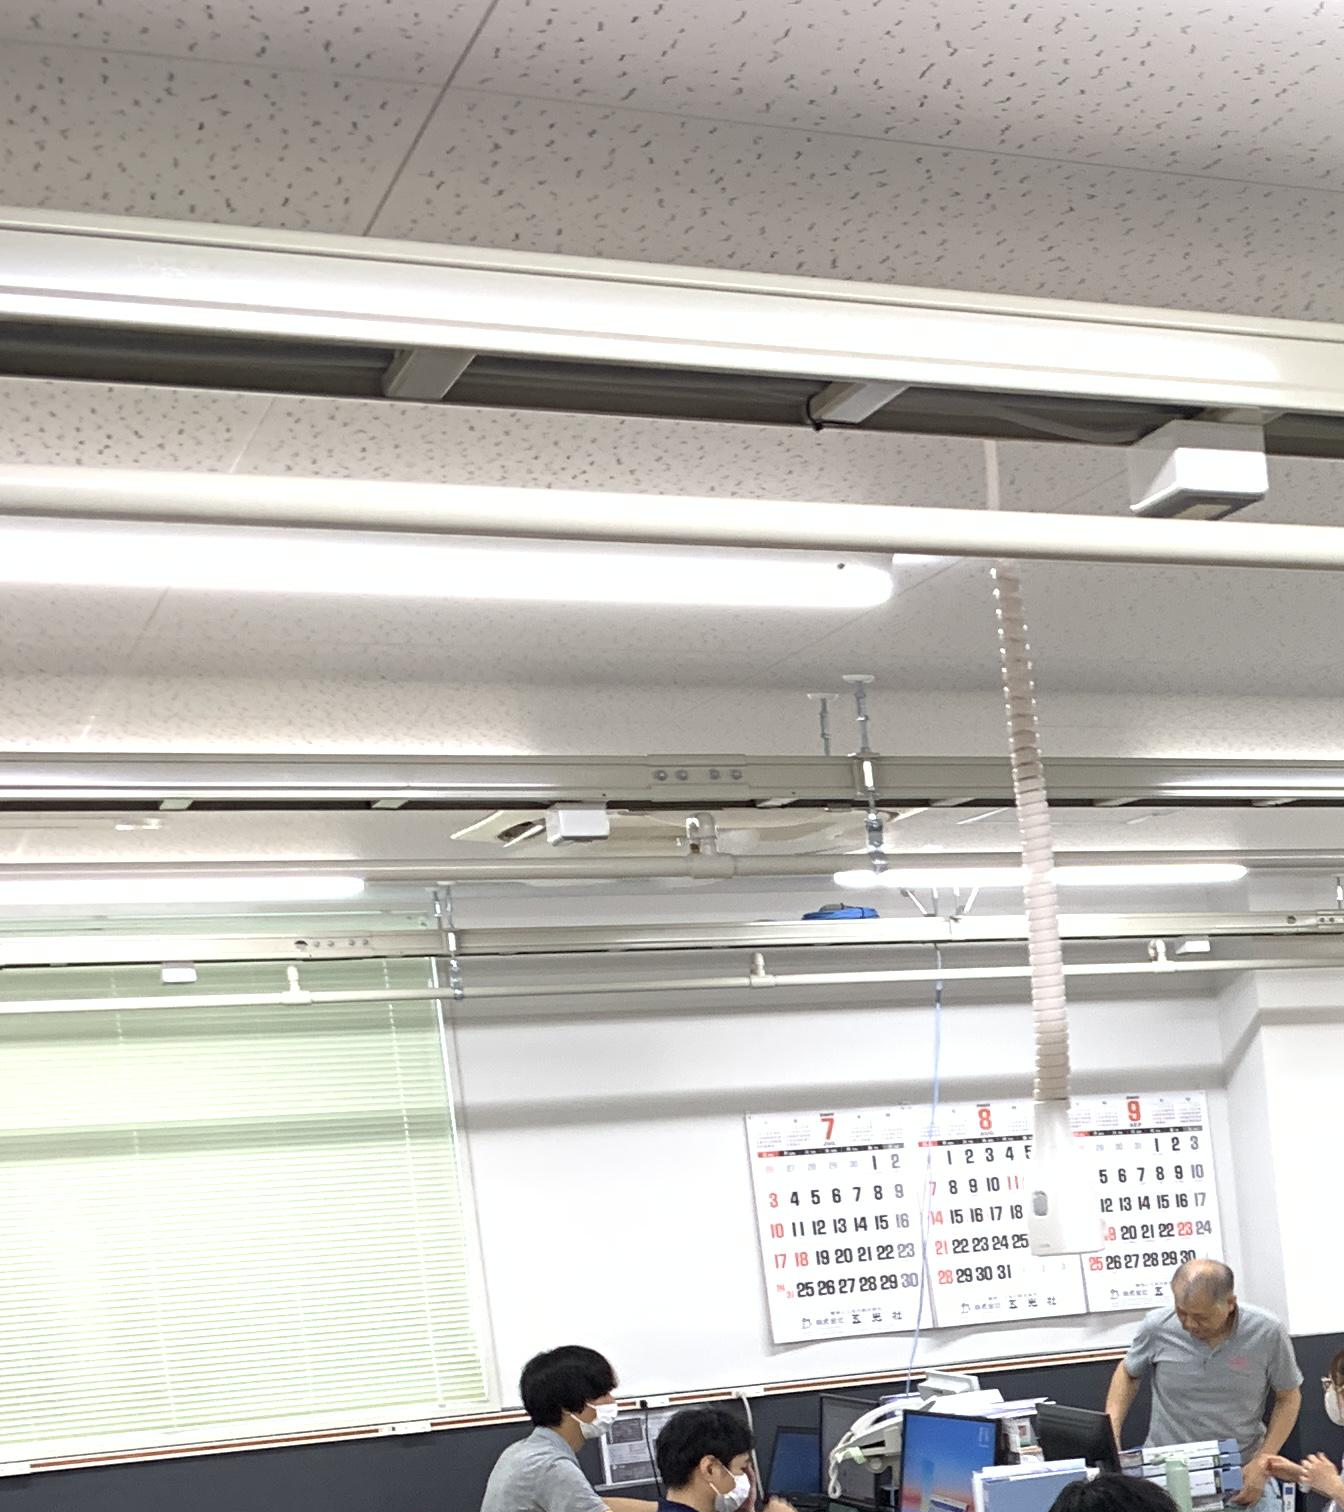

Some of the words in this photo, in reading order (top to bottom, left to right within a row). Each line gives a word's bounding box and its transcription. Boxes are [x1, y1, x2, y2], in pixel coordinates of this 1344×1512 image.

[978, 1108, 992, 1130] 8
[1128, 1100, 1141, 1121] 9
[820, 1118, 834, 1140] 7
[1154, 1138, 1160, 1152] 1
[1171, 1136, 1180, 1151] 2
[1190, 1136, 1199, 1150] 3
[872, 1155, 876, 1170] 1
[891, 1154, 900, 1168] 2
[947, 1150, 952, 1164] 1
[965, 1149, 974, 1164] 2
[986, 1148, 994, 1162] 3
[1006, 1146, 1014, 1160] 4
[1099, 1169, 1108, 1184] 5
[1118, 1168, 1127, 1182] 6
[1136, 1167, 1144, 1182] 7
[1156, 1166, 1164, 1180] 8
[1174, 1165, 1184, 1180] 9
[1191, 1164, 1204, 1179] 10
[948, 1180, 958, 1194] 8
[968, 1178, 978, 1193] 9
[986, 1176, 1000, 1192] 10
[1007, 1176, 1018, 1190] 11
[769, 1192, 778, 1208] 3
[790, 1191, 800, 1206] 4
[811, 1189, 820, 1205] 5
[832, 1188, 842, 1204] 6
[852, 1186, 861, 1202] 7
[874, 1185, 883, 1200] 8
[894, 1183, 904, 1198] 9
[1100, 1198, 1114, 1212] 12
[1119, 1196, 1132, 1211] 13
[1138, 1196, 1150, 1210] 14
[1156, 1194, 1170, 1209] 15
[1176, 1194, 1188, 1208] 16
[1194, 1192, 1206, 1206] 17
[930, 1210, 944, 1225] 14
[950, 1209, 964, 1224] 15
[970, 1208, 984, 1222] 16
[990, 1206, 1002, 1220] 17
[1010, 1204, 1024, 1220] 18
[770, 1223, 784, 1238] 10
[792, 1222, 805, 1237] 11
[812, 1220, 826, 1236] 12
[833, 1218, 847, 1234] 13
[854, 1216, 868, 1232] 14
[874, 1214, 889, 1230] 15
[896, 1212, 910, 1228] 16
[1121, 1226, 1138, 1240] 20
[1141, 1224, 1155, 1238] 21
[1158, 1222, 1174, 1237] 22
[1178, 1222, 1193, 1236] 23
[1196, 1220, 1212, 1235] 24
[935, 1240, 948, 1255] 21
[952, 1238, 970, 1254] 22
[972, 1237, 989, 1252] 23
[992, 1235, 1008, 1250] 24
[1012, 1234, 1030, 1248] 25
[774, 1254, 786, 1268] 17
[795, 1252, 808, 1267] 18
[816, 1250, 830, 1266] 19
[834, 1248, 853, 1264] 20
[858, 1246, 872, 1262] 21
[876, 1244, 894, 1260] 22
[898, 1242, 915, 1258] 23
[1089, 1256, 1104, 1271] 25
[1106, 1255, 1122, 1270] 26
[1124, 1254, 1140, 1268] 27
[1143, 1252, 1159, 1268] 28
[1162, 1251, 1178, 1266] 29
[938, 1270, 953, 1284] 28
[956, 1268, 973, 1283] 29
[976, 1266, 993, 1280] 30
[997, 1264, 1012, 1279] 31
[796, 1282, 814, 1298] 25
[818, 1280, 836, 1296] 26
[838, 1278, 856, 1294] 27
[859, 1276, 878, 1292] 28
[880, 1274, 898, 1290] 29
[900, 1272, 918, 1288] 30
